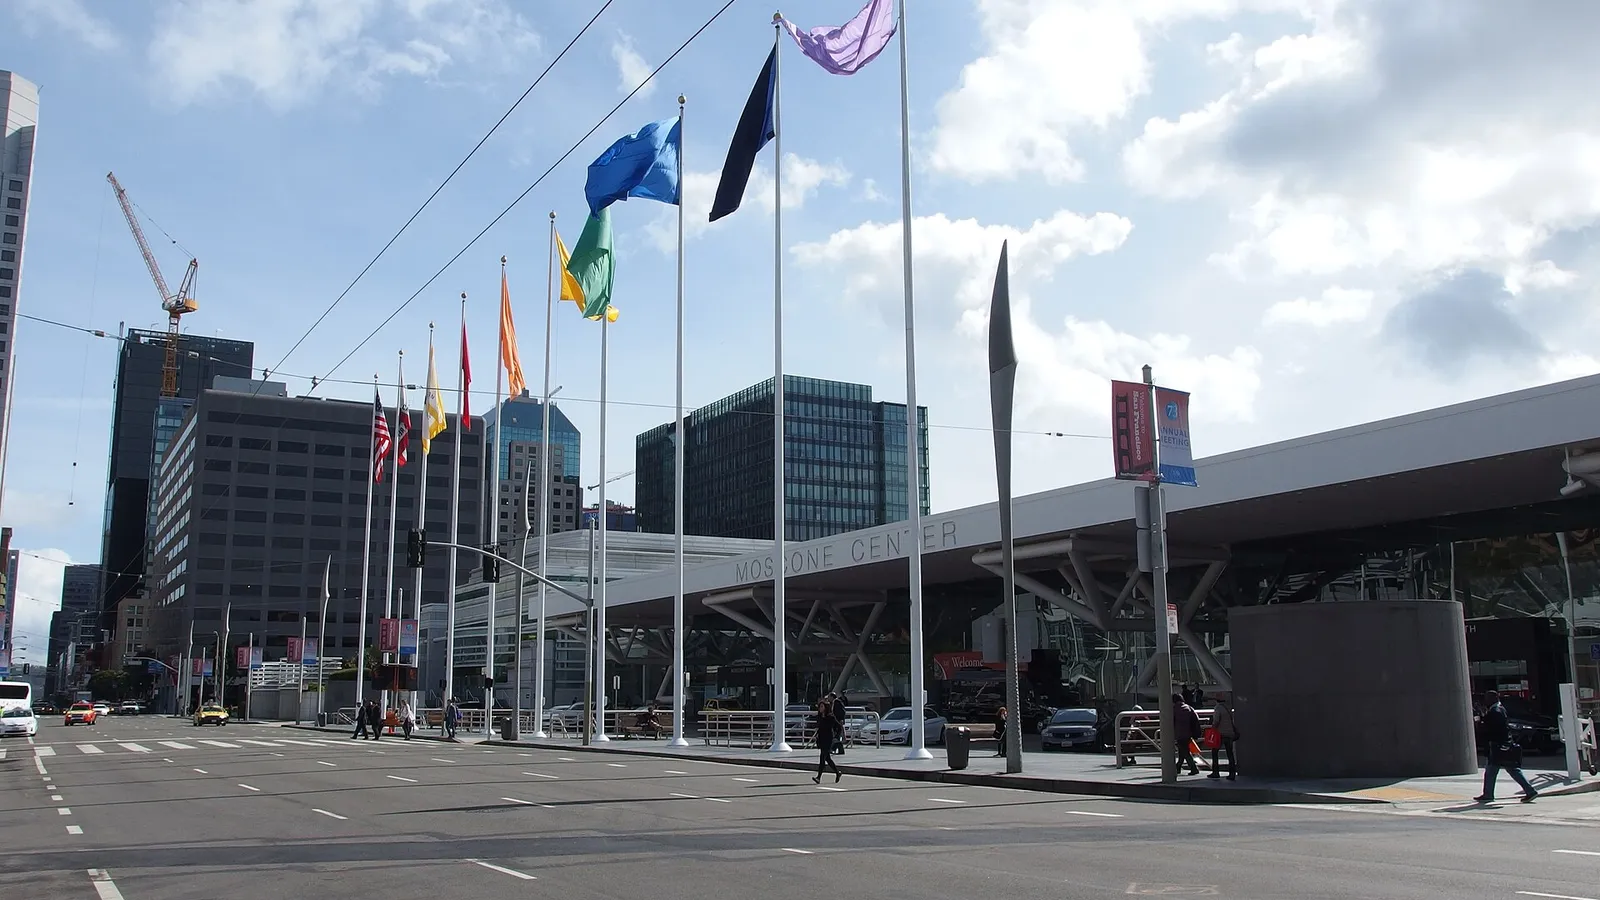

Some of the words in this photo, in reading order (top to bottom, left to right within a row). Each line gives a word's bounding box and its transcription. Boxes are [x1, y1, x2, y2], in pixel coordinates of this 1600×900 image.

[1133, 410, 1142, 461] Francisco
[735, 545, 833, 582] MOSONE
[951, 656, 984, 668] Welcome
